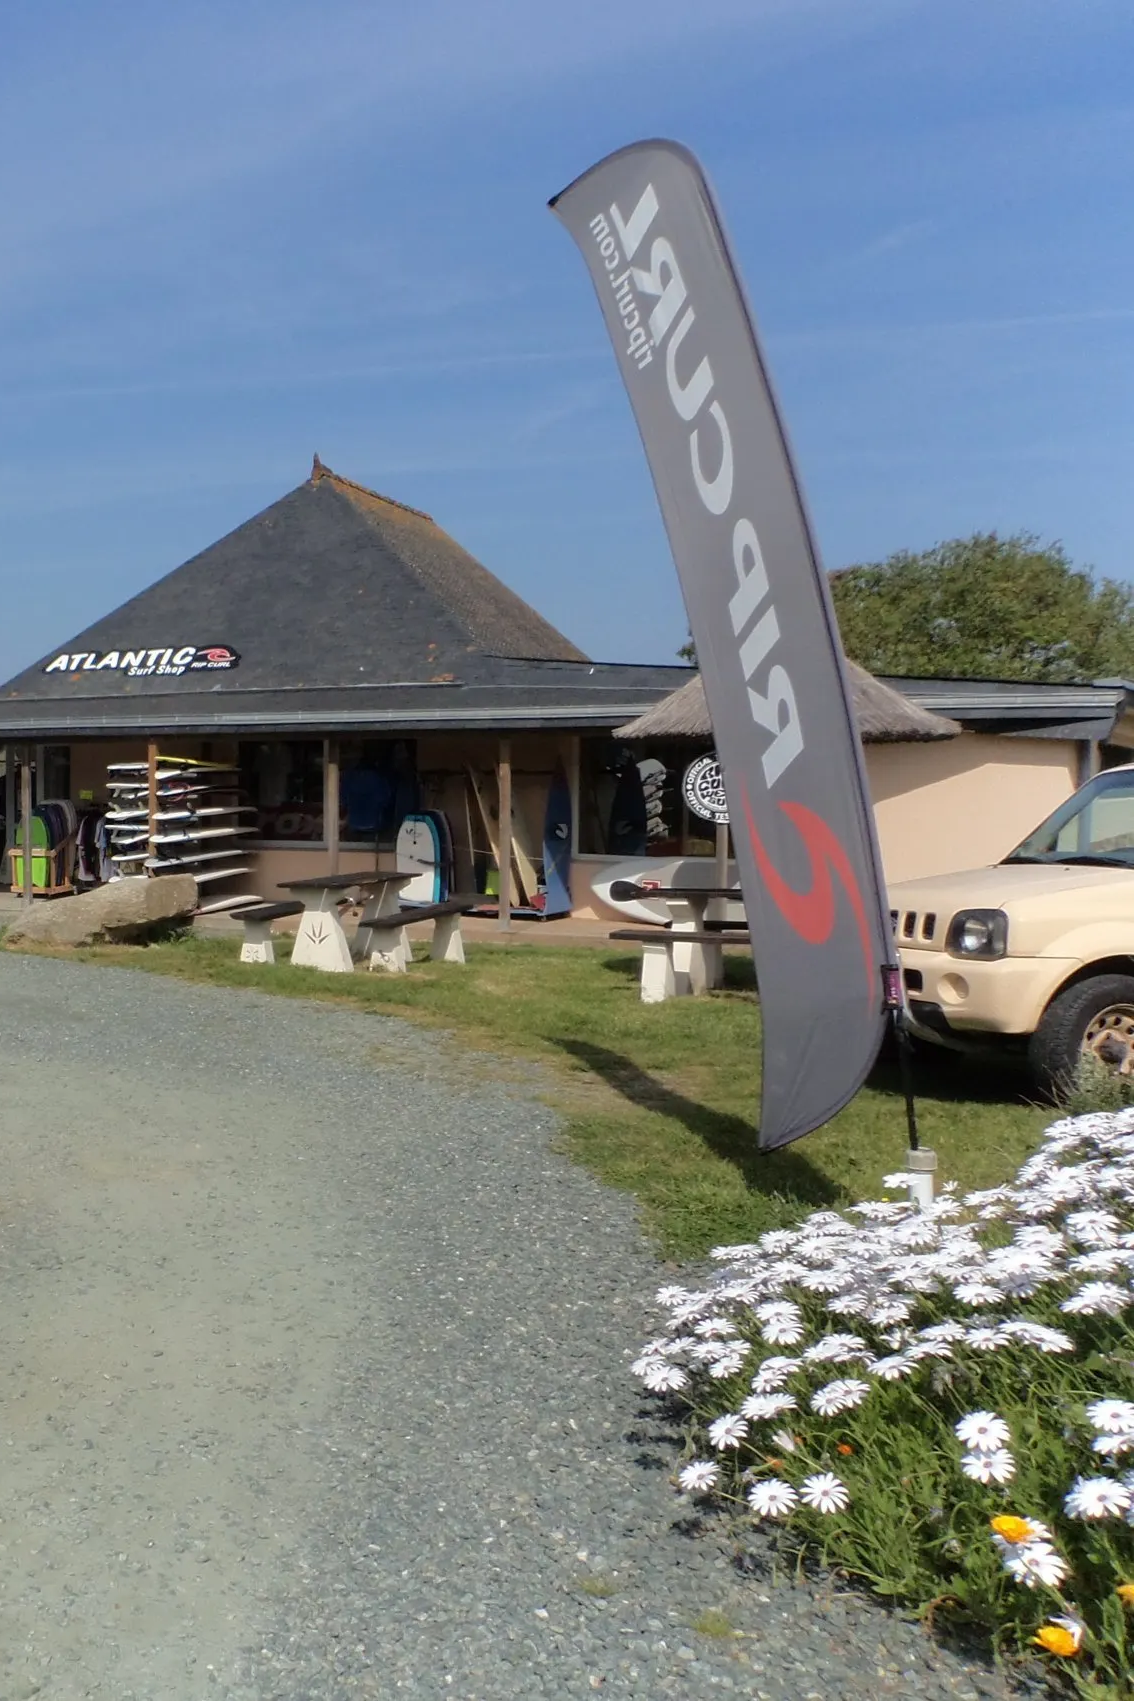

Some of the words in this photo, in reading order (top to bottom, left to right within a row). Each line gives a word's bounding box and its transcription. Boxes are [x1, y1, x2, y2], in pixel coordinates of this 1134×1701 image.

[46, 647, 197, 672] ATLANTIC
[127, 665, 156, 676] Surf
[156, 664, 186, 676] Shop
[686, 791, 713, 818] OFFICIAL
